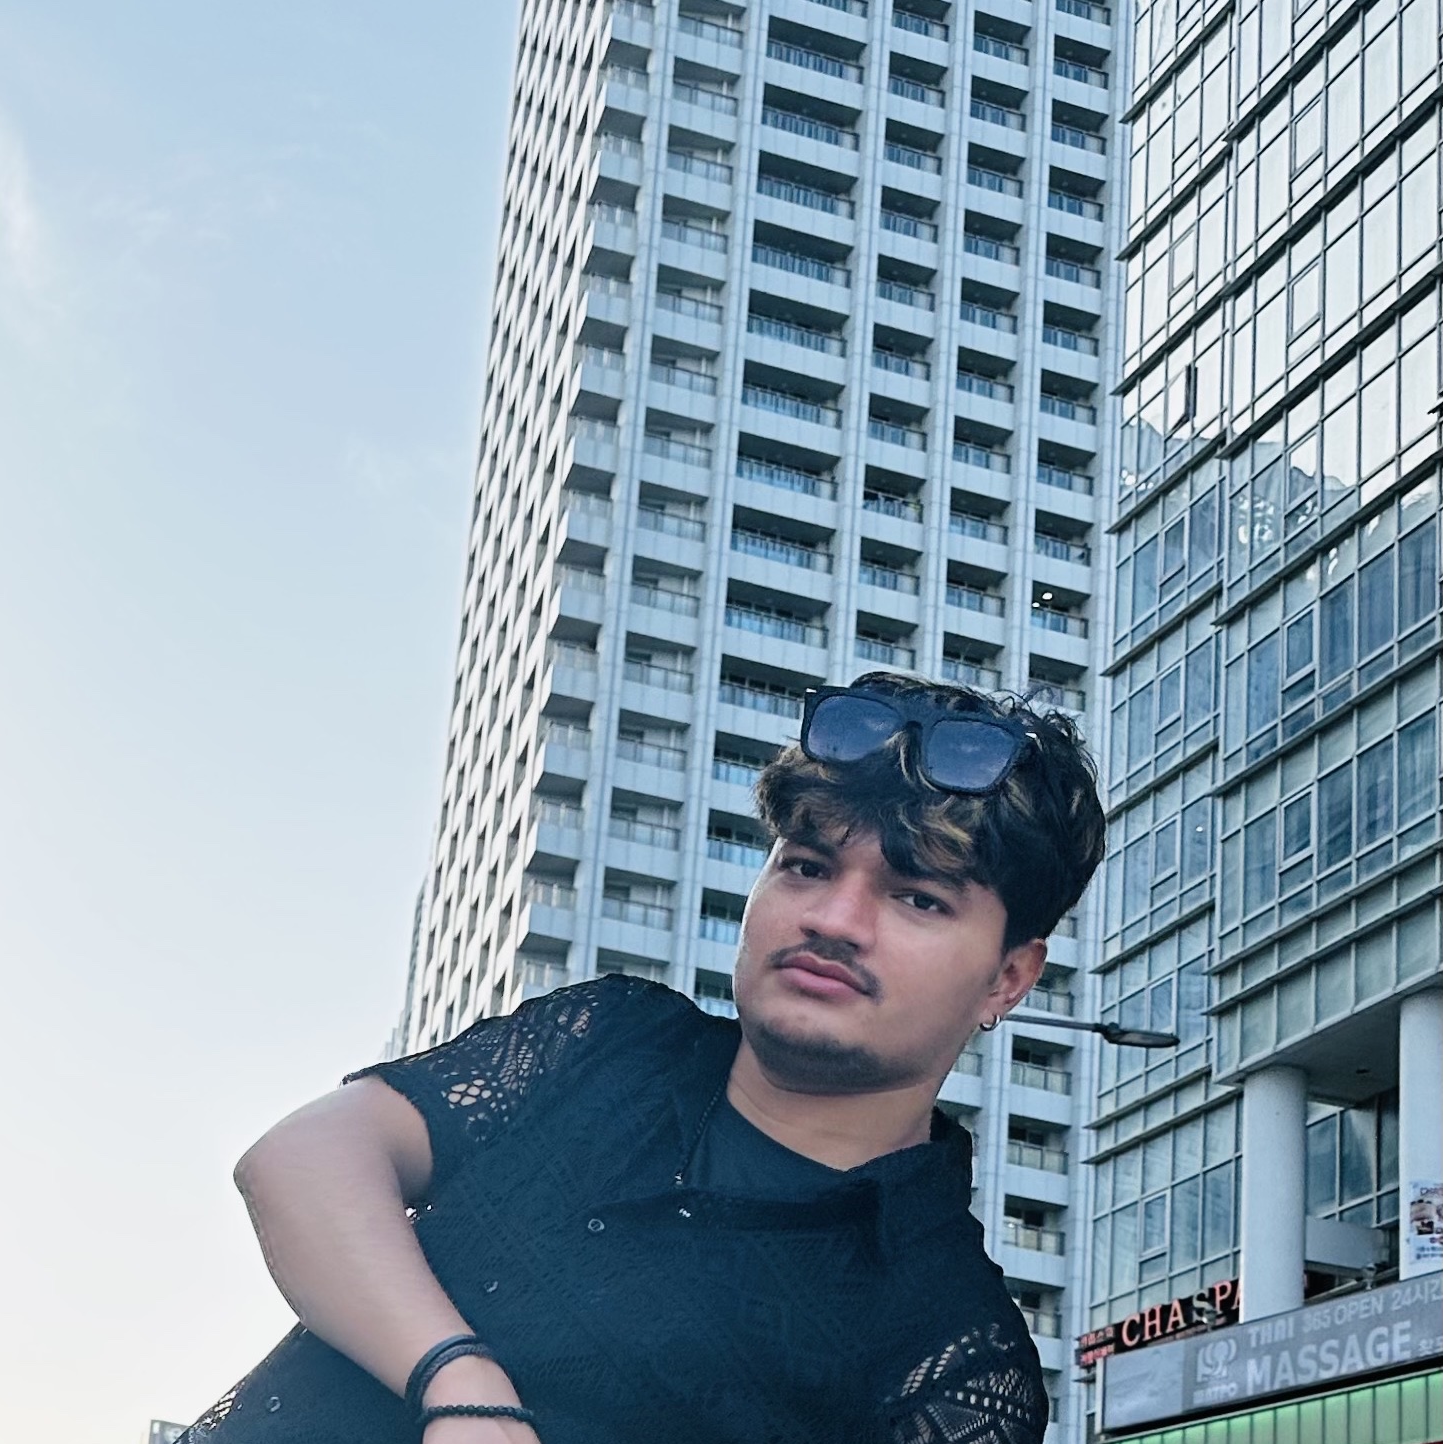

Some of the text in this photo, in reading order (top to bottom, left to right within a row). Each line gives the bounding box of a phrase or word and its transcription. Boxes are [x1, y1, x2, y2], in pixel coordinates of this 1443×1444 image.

[1248, 1317, 1294, 1347] THAI
[1334, 1294, 1384, 1325] OPEN
[1246, 1320, 1412, 1396] MASSAGE
